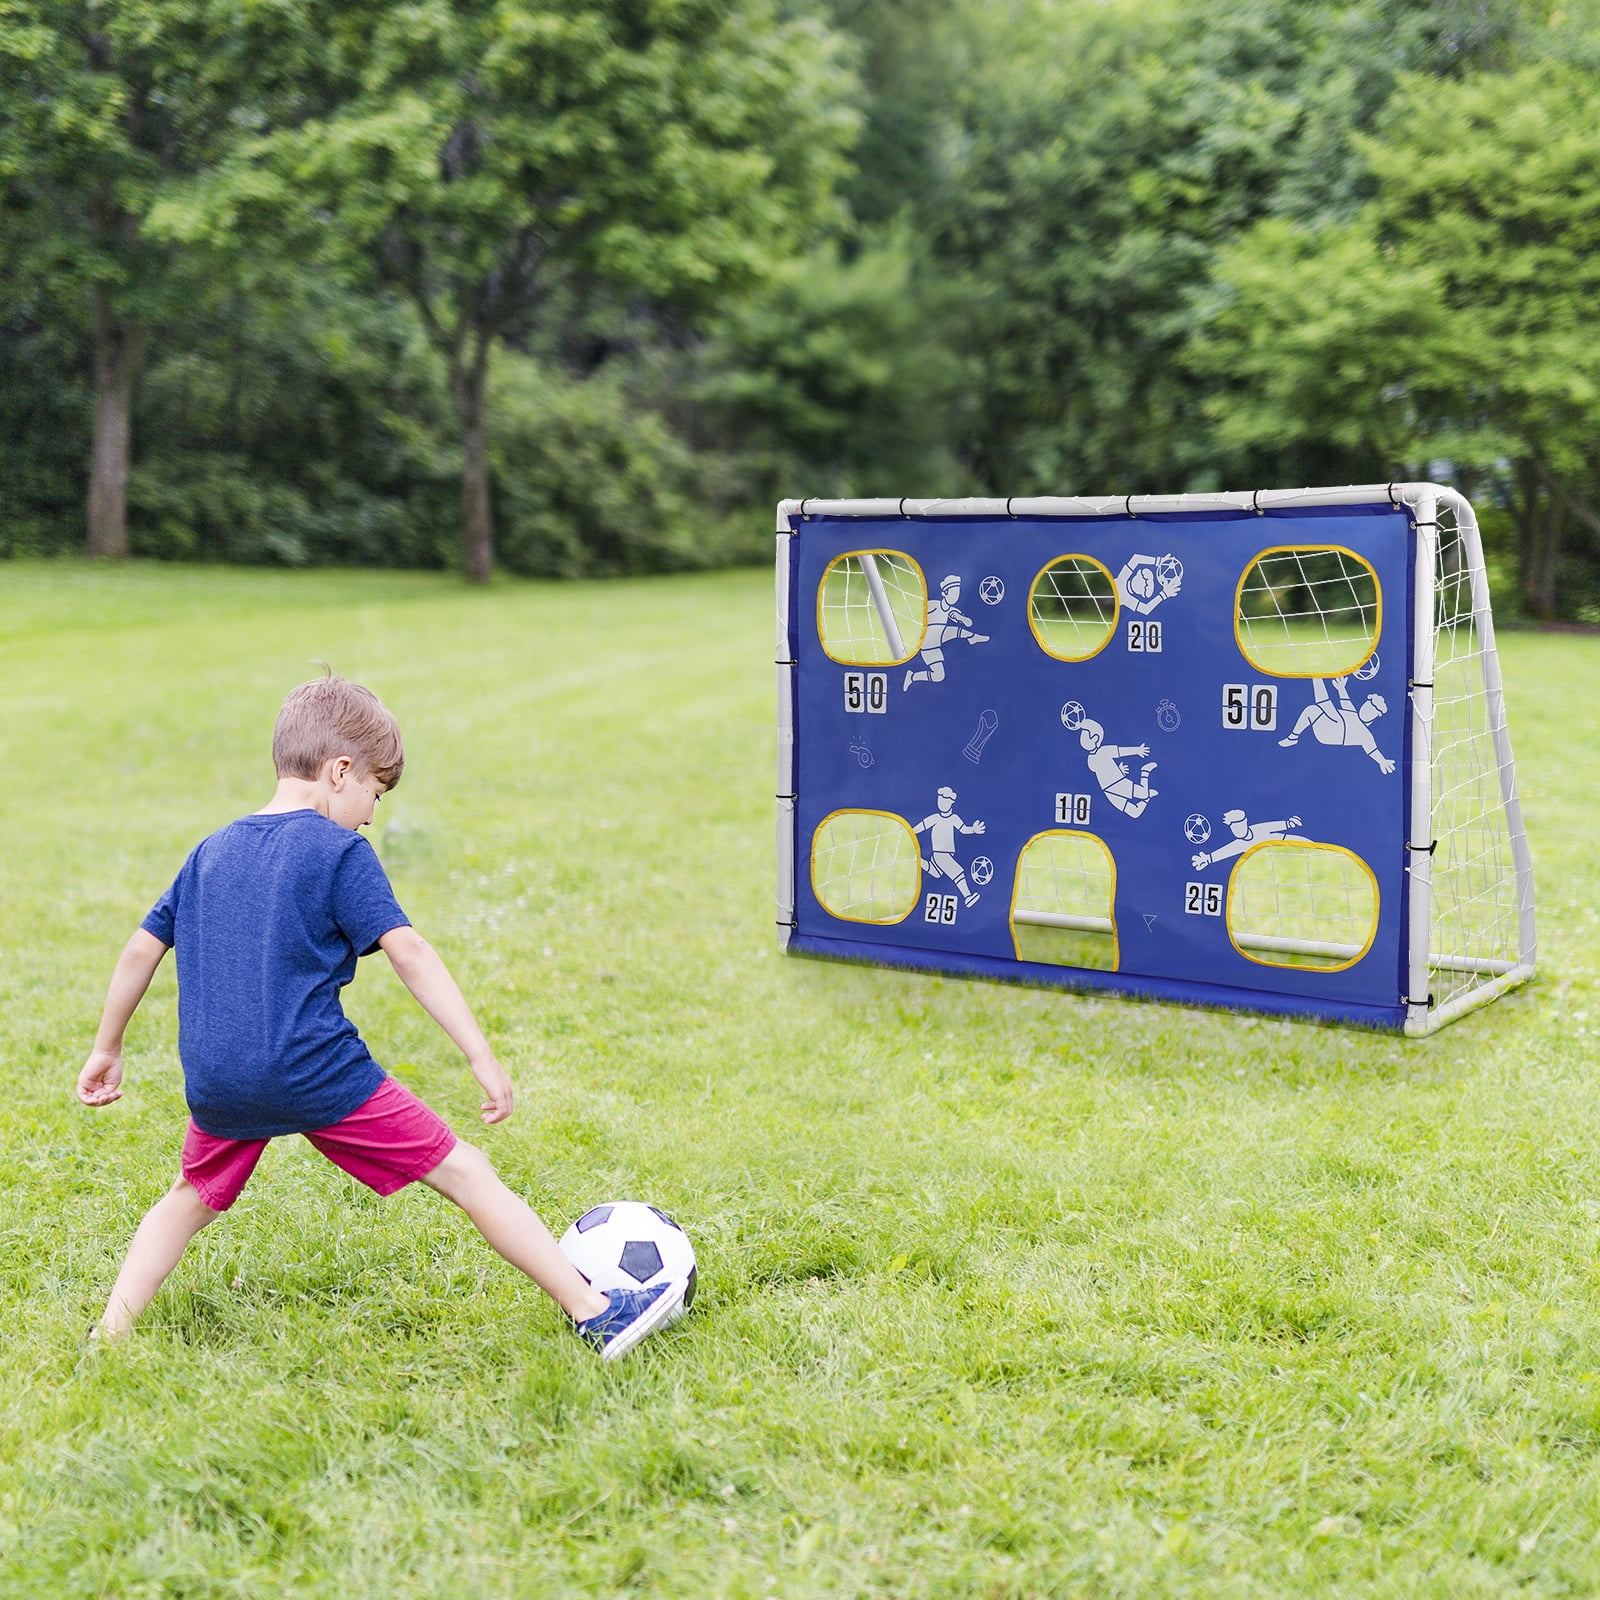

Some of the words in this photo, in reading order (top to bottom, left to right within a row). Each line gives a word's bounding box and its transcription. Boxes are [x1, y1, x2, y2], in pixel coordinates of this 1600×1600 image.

[1131, 624, 1159, 649] 20
[848, 676, 884, 709] 50
[1227, 688, 1272, 725] 50
[1059, 796, 1087, 821] 10
[928, 896, 955, 922] 25
[1188, 885, 1220, 913] 25
